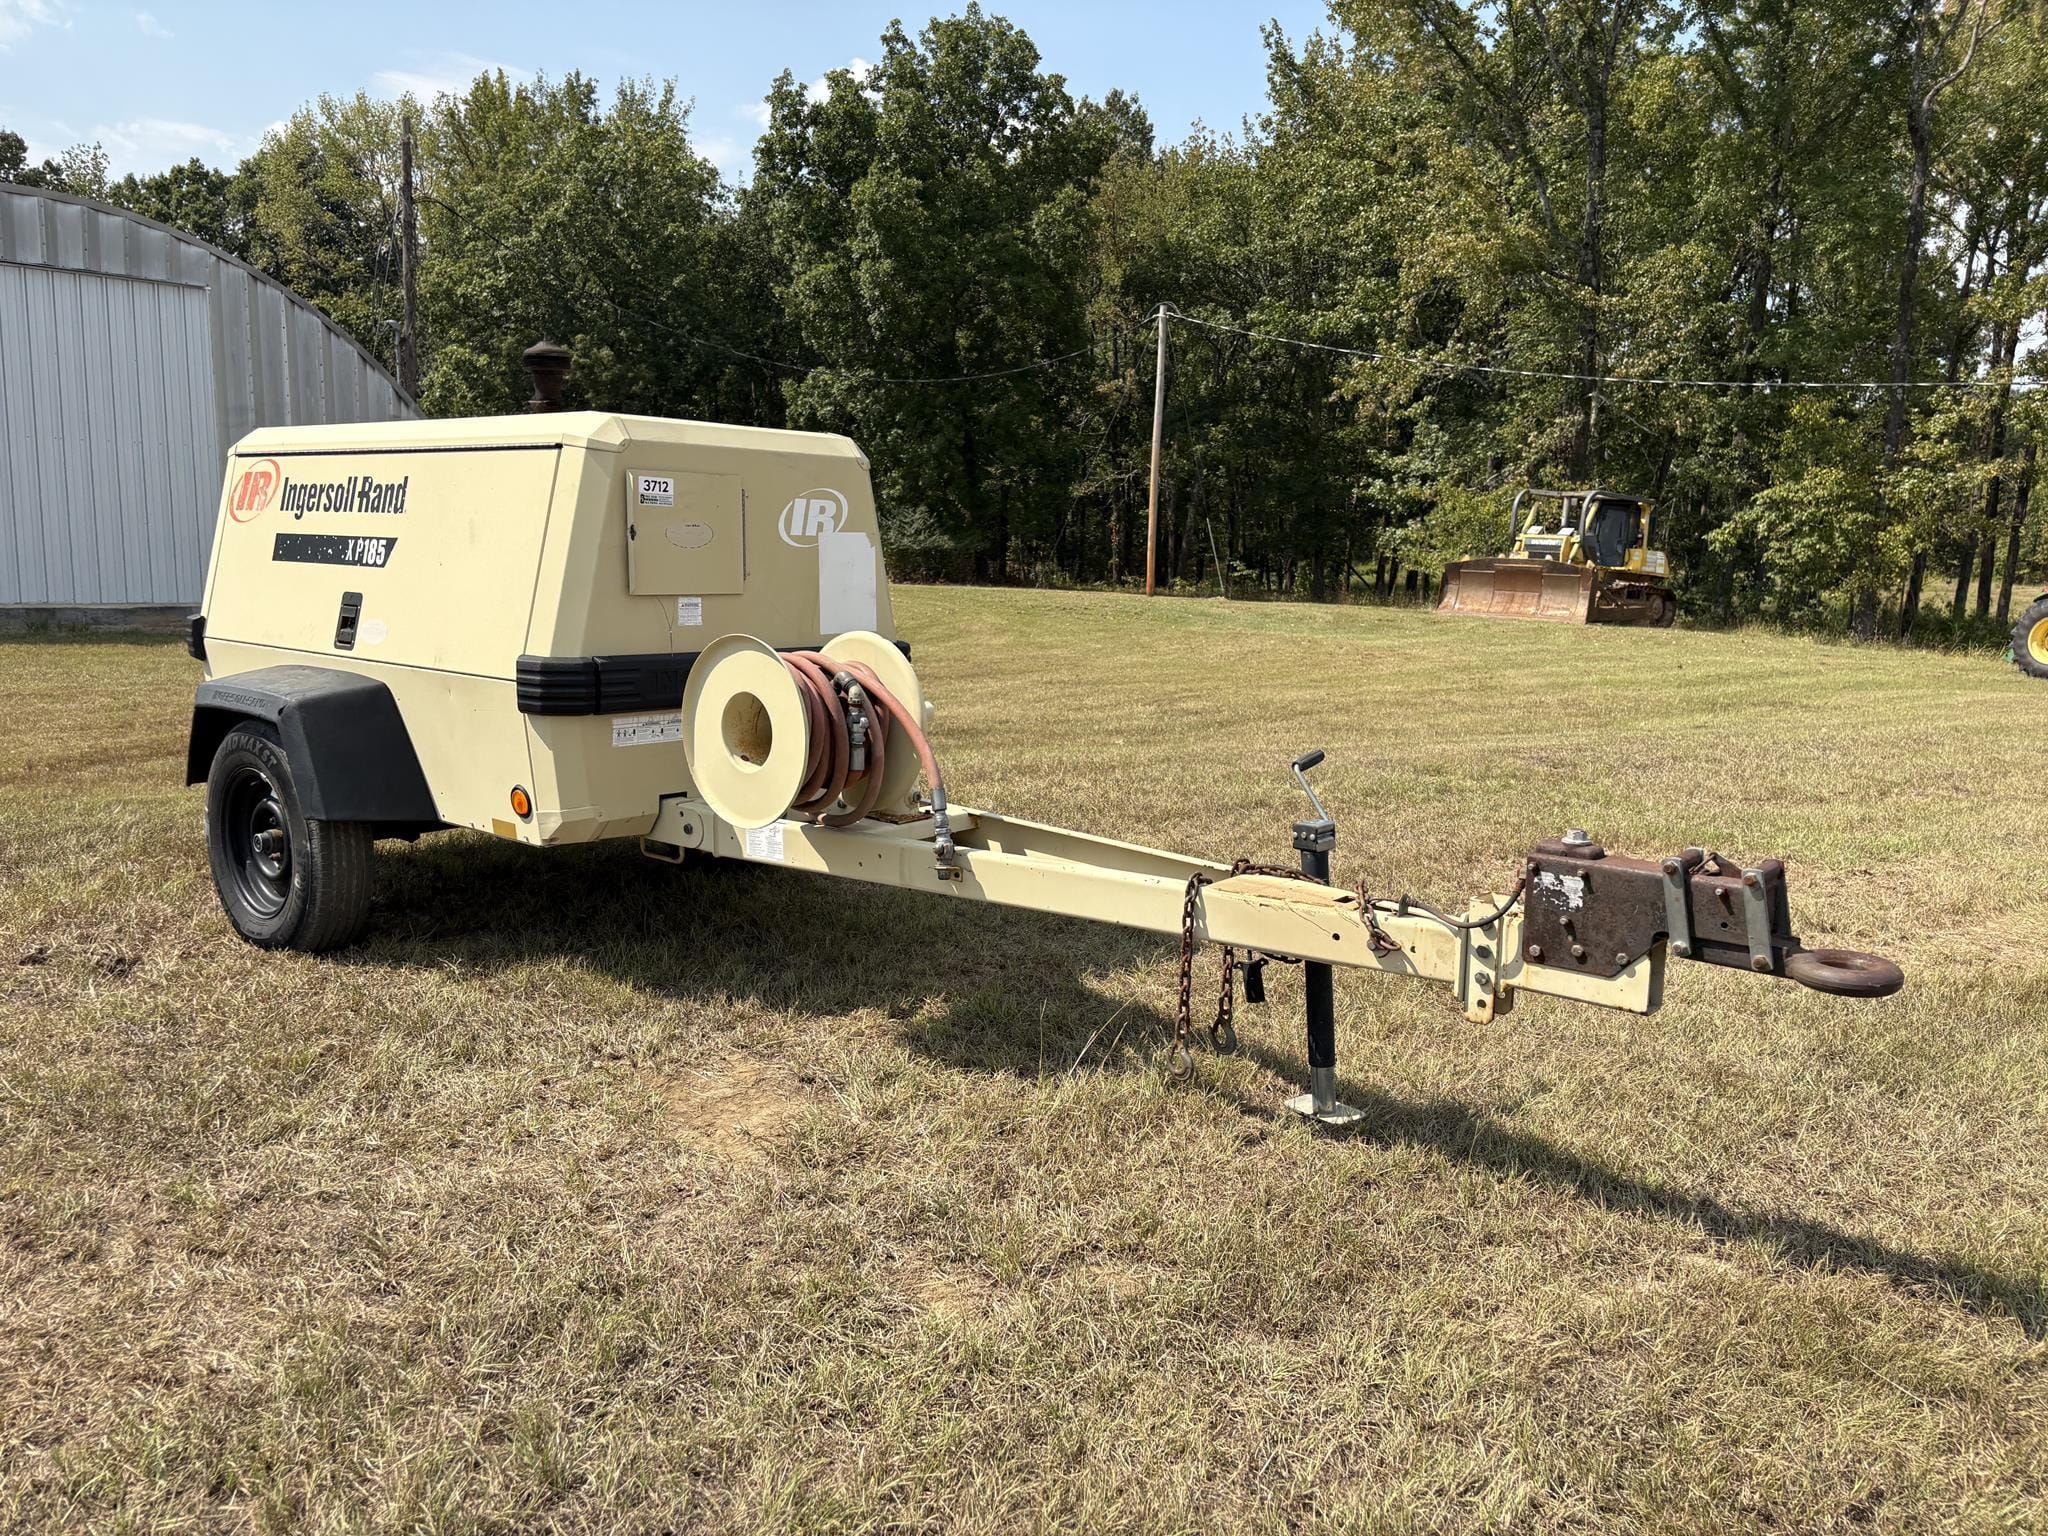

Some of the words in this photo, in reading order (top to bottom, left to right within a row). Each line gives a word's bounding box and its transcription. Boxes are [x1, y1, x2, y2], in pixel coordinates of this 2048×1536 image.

[236, 471, 272, 511] IR
[643, 479, 669, 493] 3712
[790, 498, 837, 537] IR
